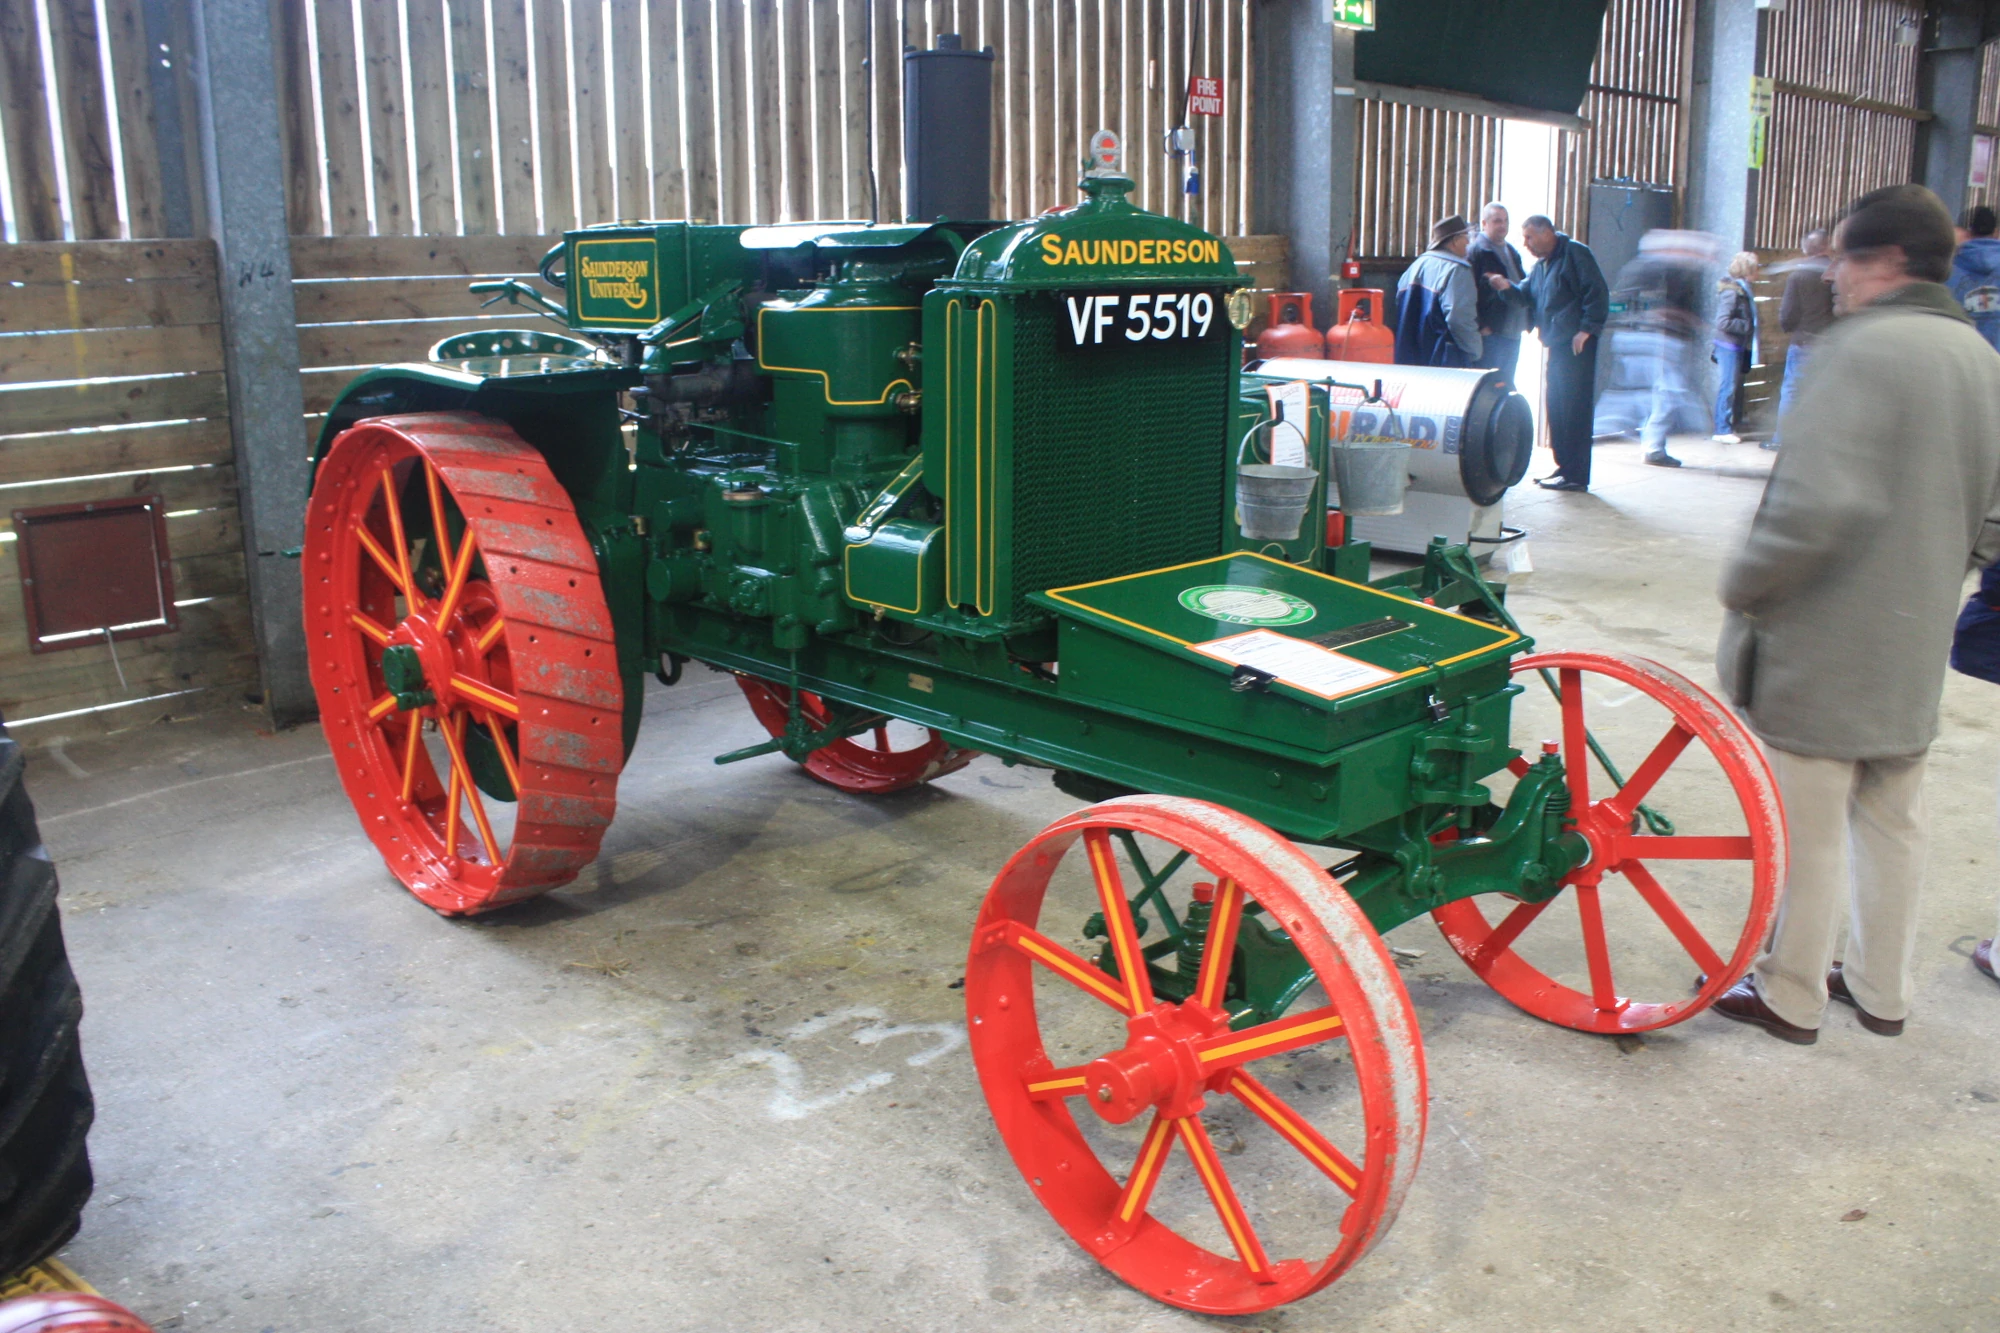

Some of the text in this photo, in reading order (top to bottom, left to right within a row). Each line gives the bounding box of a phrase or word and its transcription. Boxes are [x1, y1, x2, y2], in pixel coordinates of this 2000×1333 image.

[1197, 78, 1218, 96] FIRE
[1191, 96, 1221, 114] POINT
[1041, 233, 1220, 265] SAUNDERSON
[581, 256, 649, 282] SAUNDERSON
[588, 279, 648, 309] UNIVERSAL
[1067, 292, 1214, 346] VF 5519
